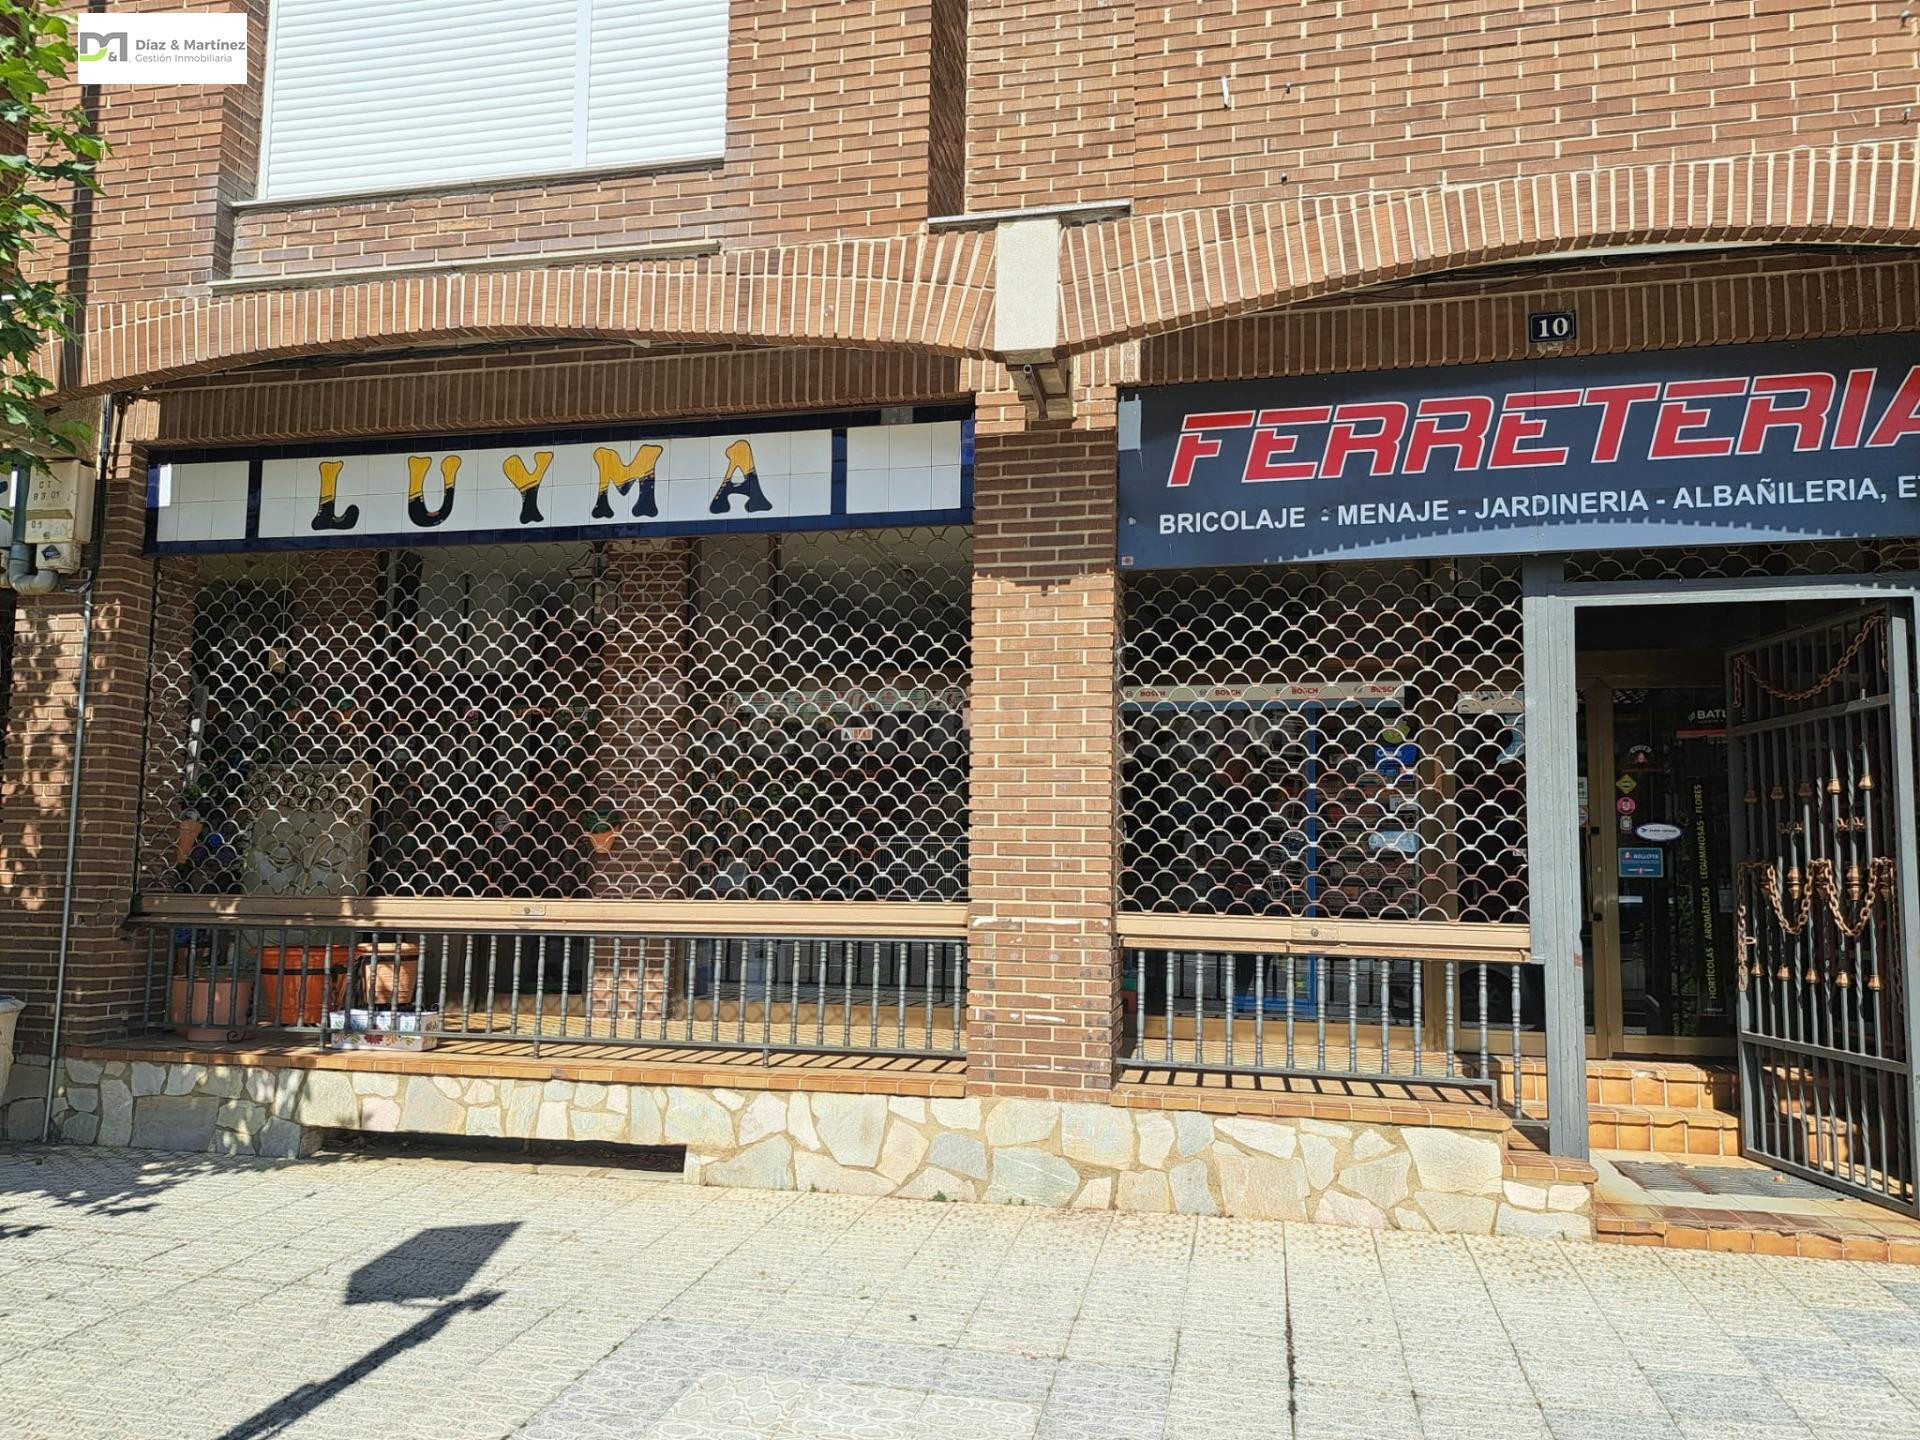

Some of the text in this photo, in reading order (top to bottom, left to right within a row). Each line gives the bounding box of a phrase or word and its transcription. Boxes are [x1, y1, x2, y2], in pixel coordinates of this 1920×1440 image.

[1538, 317, 1569, 338] 10
[311, 439, 773, 531] LUYMA
[1159, 507, 1306, 535] BRICOLAJE
[1337, 500, 1449, 526] MENAJE
[1474, 489, 1649, 519] JARDINERIA
[1673, 477, 1887, 510] ALBAÑILERIA,
[1898, 474, 1920, 499] E
[1693, 784, 1704, 814] FLORES
[1697, 820, 1708, 880] LEGUMINOSAS
